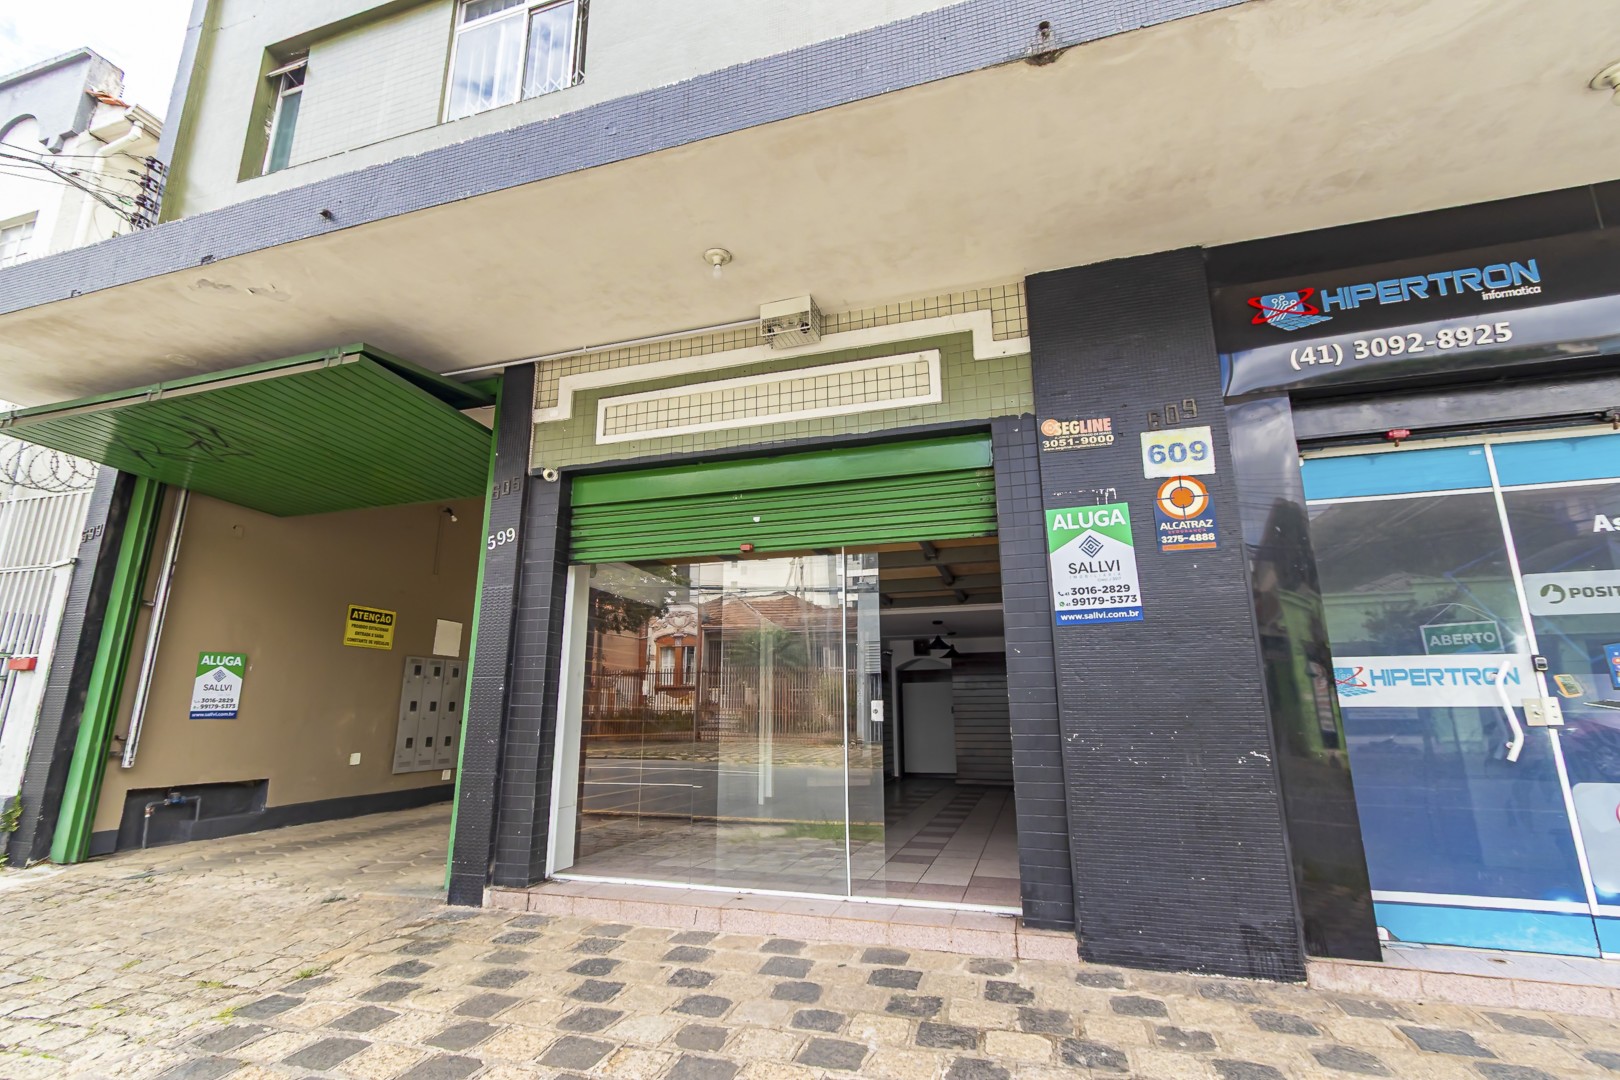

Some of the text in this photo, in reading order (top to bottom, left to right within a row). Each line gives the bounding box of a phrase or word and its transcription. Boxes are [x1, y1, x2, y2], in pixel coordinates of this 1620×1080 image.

[1320, 259, 1540, 313] HIPERTRON
[1290, 322, 1513, 370] (41) 3092-8925
[1147, 399, 1198, 430] 609
[1054, 417, 1112, 436] SEGLINE
[1042, 435, 1114, 448] 3051-9000
[1148, 441, 1208, 464] 609
[1053, 509, 1126, 531] ALUGA
[1160, 519, 1213, 530] ALCATRAZ
[487, 527, 515, 550] 599
[1161, 533, 1215, 543] 3275-4888
[1068, 560, 1120, 574] SALLVI
[1070, 584, 1130, 596] 3016-2829
[1072, 594, 1137, 606] 99179-5373
[352, 610, 391, 624] ATENÇÃO
[1060, 610, 1139, 621] www.sallvi.com.br
[1430, 631, 1496, 646] ABERTO
[200, 655, 242, 666] ALUGA
[203, 684, 232, 692] SALLVI
